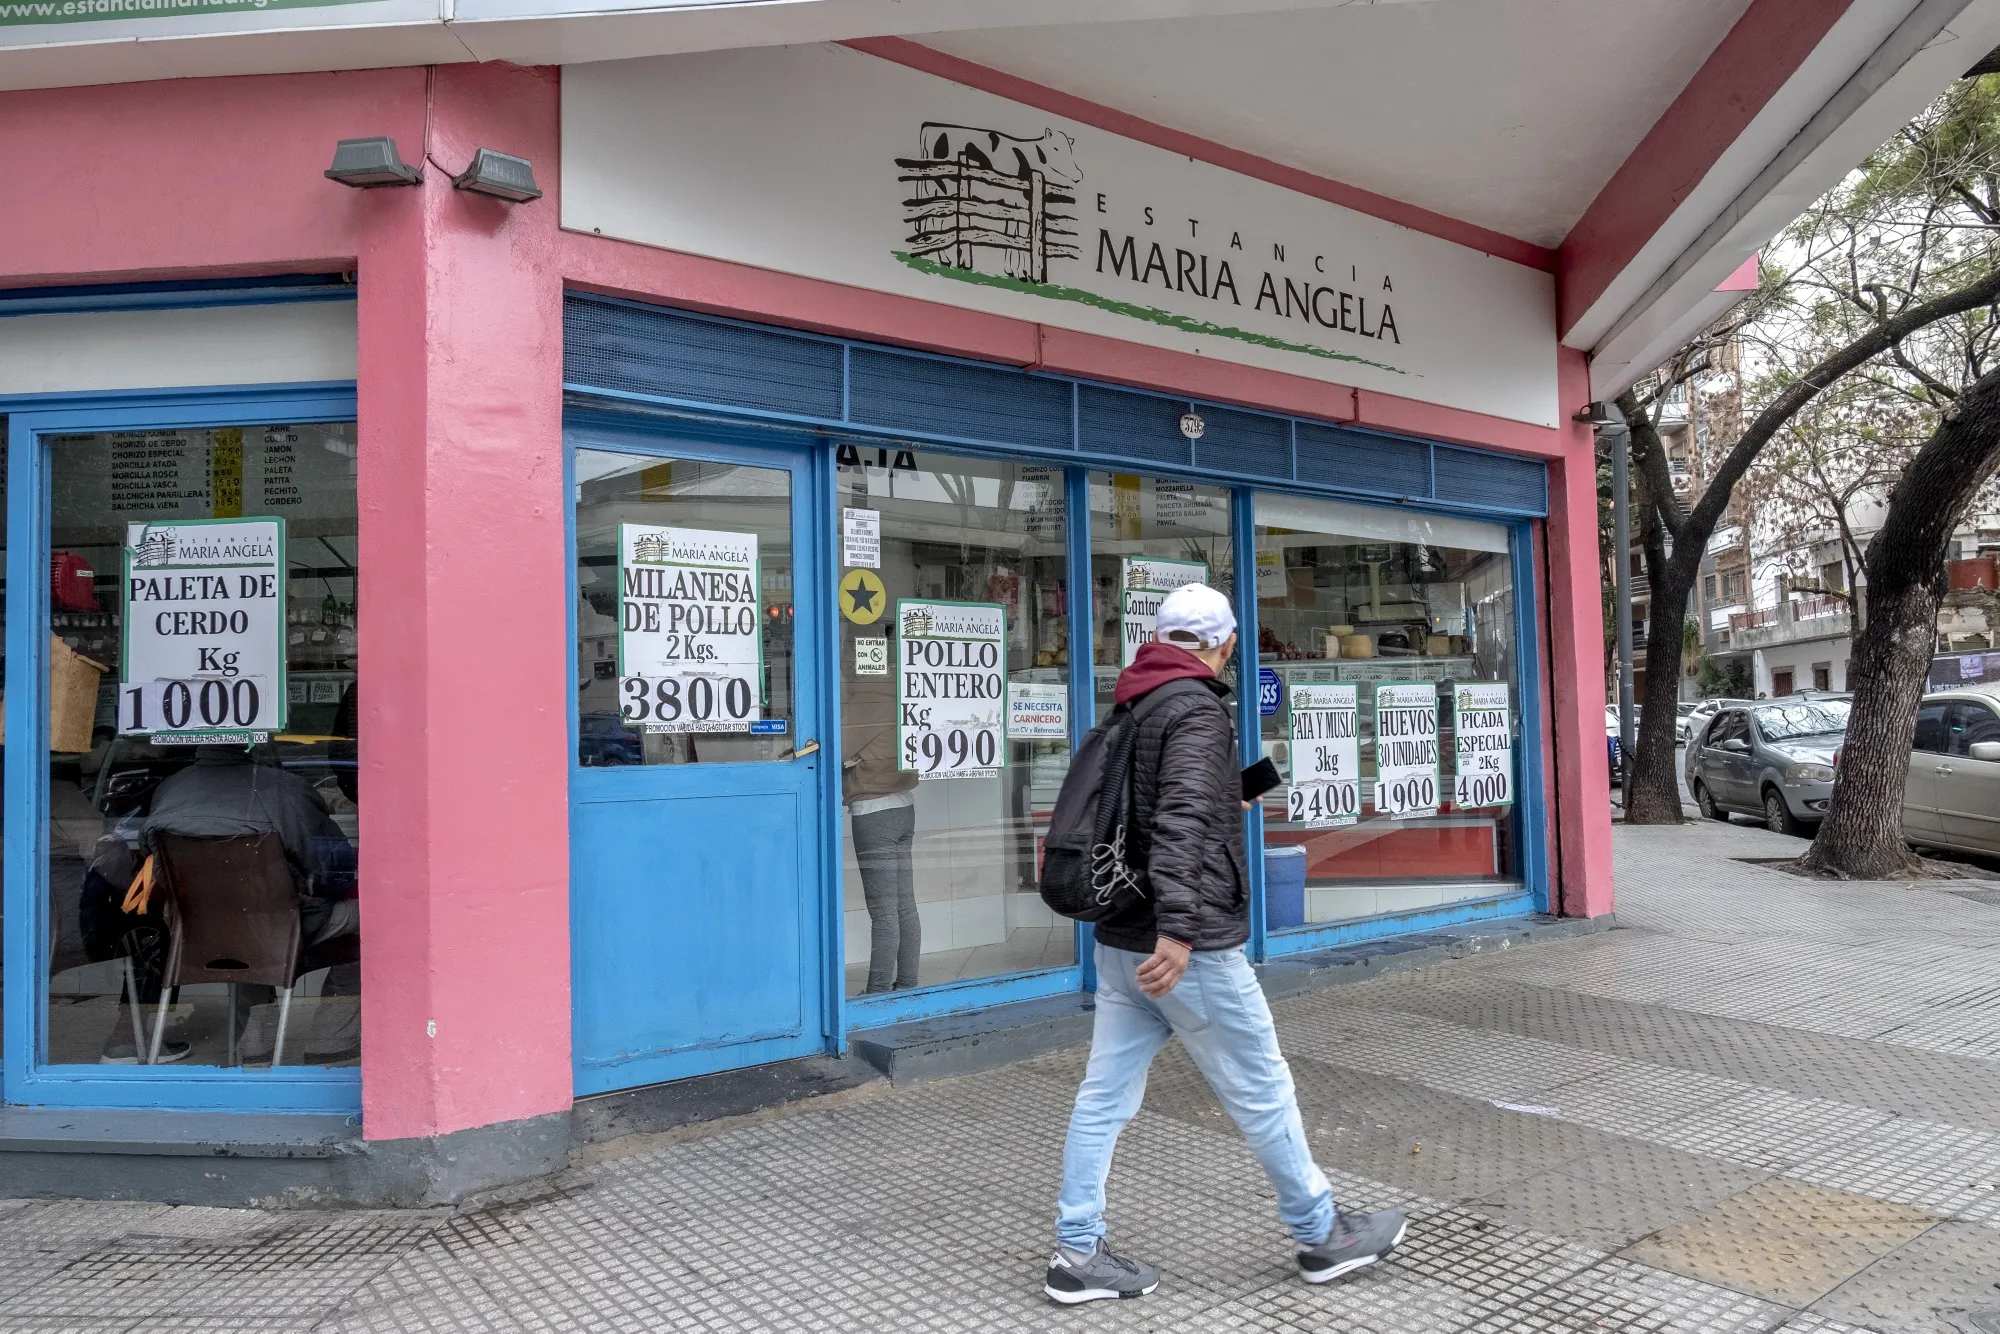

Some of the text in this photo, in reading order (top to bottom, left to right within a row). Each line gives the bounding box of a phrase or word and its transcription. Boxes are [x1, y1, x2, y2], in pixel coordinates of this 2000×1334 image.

[1096, 192, 1393, 293] ESTANCIA
[1096, 229, 1401, 345] MARIA ANGELA
[1184, 416, 1203, 435] 3795
[112, 441, 146, 449] CHORIZO
[161, 440, 187, 448] CERDO
[149, 450, 185, 458] ESPECIAL
[112, 462, 150, 470] MORCILLA
[265, 456, 296, 464] LECHON
[112, 472, 150, 480] MORCILLA
[265, 477, 290, 485] PATITA
[112, 493, 154, 501] SALCHICHA
[157, 491, 203, 499] PARRILLERA
[265, 487, 298, 495] PECHITO
[112, 503, 154, 511] SALCHICHA
[265, 498, 303, 506] CORDERO
[1183, 501, 1212, 509] AHUMADA
[178, 545, 274, 559] MARIA ANGELA
[671, 549, 749, 563] MARIA ANGELA
[130, 575, 277, 601] PALETA DE
[624, 568, 757, 603] MILANESA
[1152, 577, 1175, 588] MARIA
[156, 610, 249, 636] CERDO
[624, 602, 755, 636] DE POLLO
[935, 623, 1000, 635] MARIA ANGELA
[1125, 622, 1154, 644] Wha
[666, 635, 718, 664] 2 Kgs.
[906, 640, 998, 668] POLLO
[198, 647, 241, 677] Kg
[905, 672, 1002, 699] ENTERO
[623, 677, 751, 721] 3800
[1013, 702, 1063, 711] SE NECESITA
[1473, 697, 1507, 705] MARIA ANGELA
[901, 703, 932, 731] Kg
[1014, 714, 1061, 723] CARNICERO
[1291, 711, 1357, 740] PATA Y MUSLO
[1379, 709, 1436, 736] HUEVOS
[1461, 711, 1504, 729] PICADA
[646, 723, 676, 733] PROMOCION
[732, 722, 748, 732] STOCK
[905, 729, 995, 773] $990
[1457, 733, 1511, 752] ESPECIAL
[1315, 745, 1339, 776] 3kg
[1379, 740, 1437, 768] 30 UNIDADES
[1478, 755, 1500, 773] 2Kg
[1378, 778, 1433, 812] 1900
[1457, 773, 1507, 807] 4000
[1291, 784, 1356, 821] 2400
